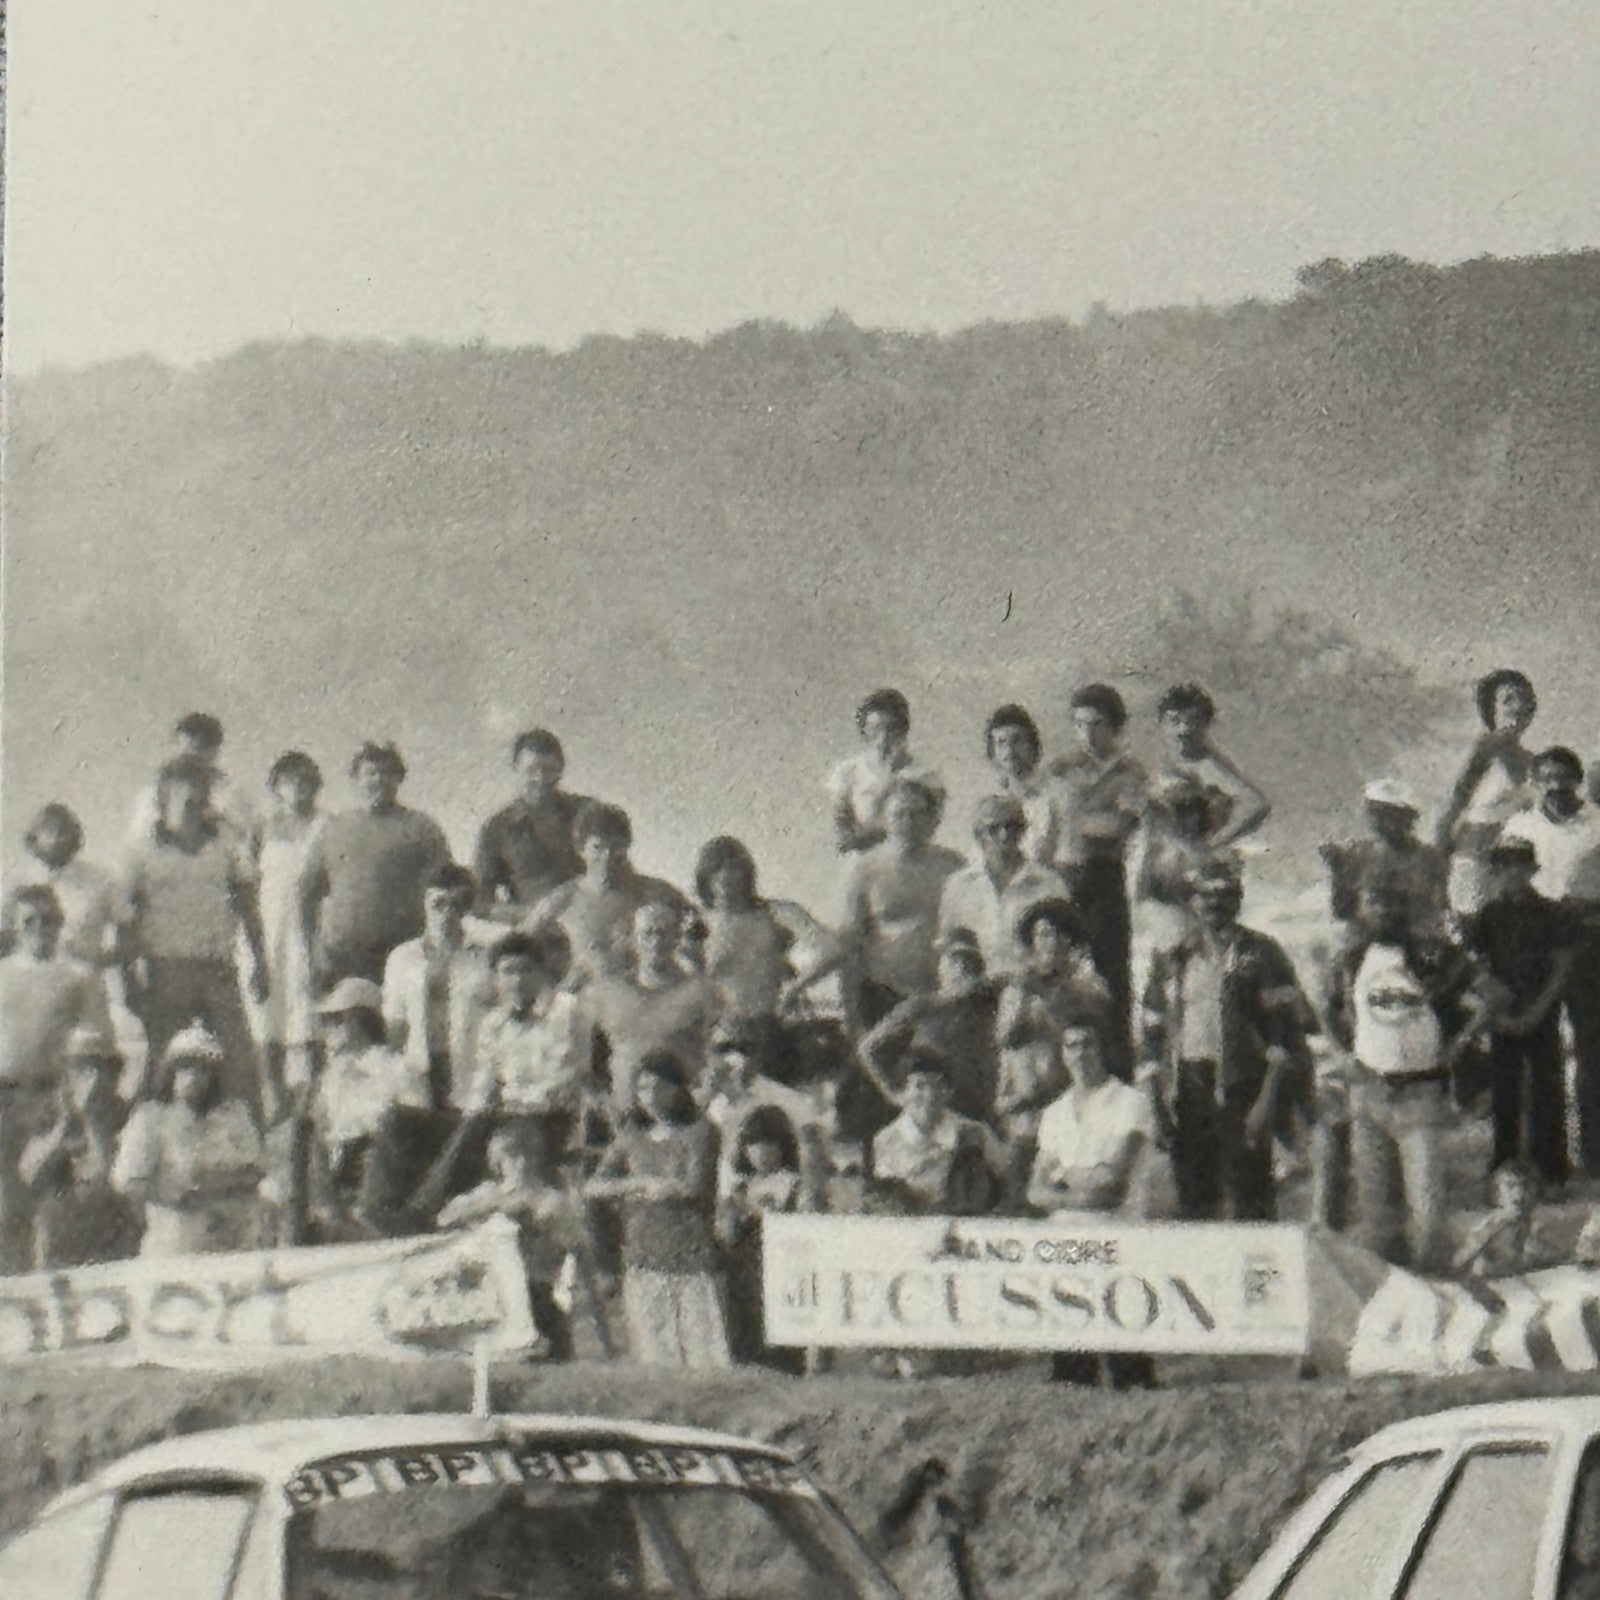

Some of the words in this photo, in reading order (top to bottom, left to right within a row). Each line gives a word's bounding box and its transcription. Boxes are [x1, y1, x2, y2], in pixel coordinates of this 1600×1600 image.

[284, 1463, 358, 1506] BP
[398, 1455, 476, 1486] BP
[517, 1452, 589, 1484] BP
[631, 1452, 699, 1485] BP
